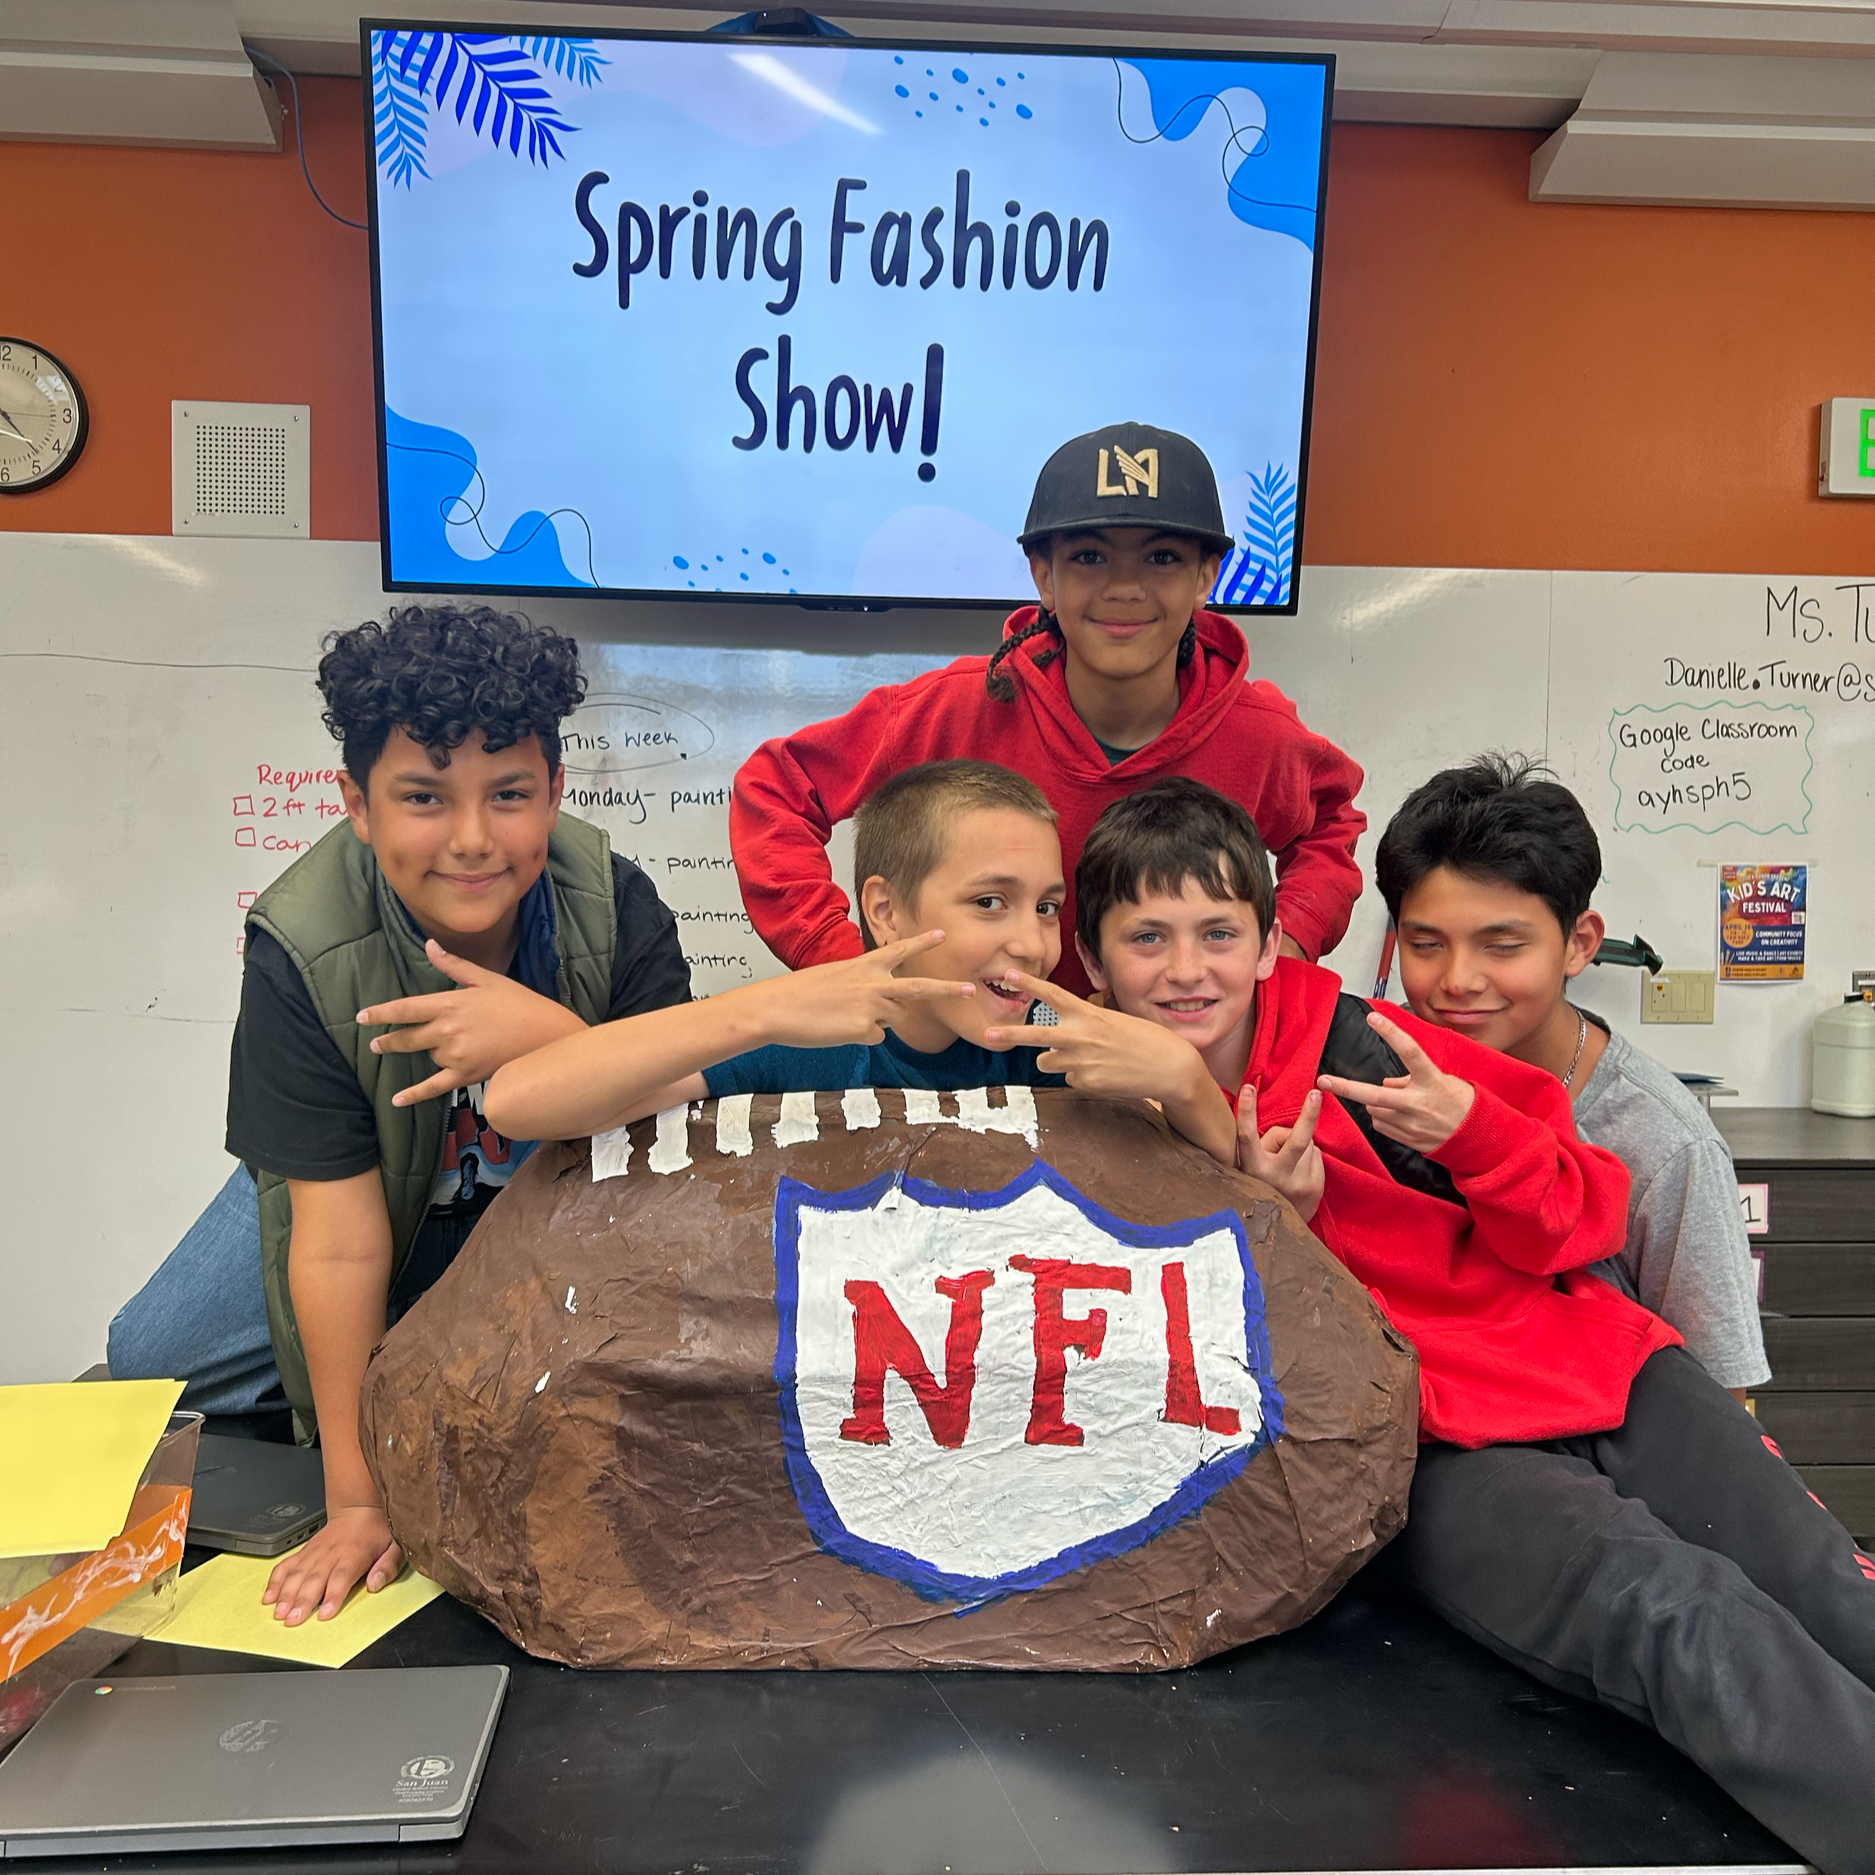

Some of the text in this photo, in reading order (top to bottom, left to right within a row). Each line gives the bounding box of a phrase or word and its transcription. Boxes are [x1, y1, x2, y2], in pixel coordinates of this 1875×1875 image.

[573, 169, 1110, 316] Spring Fashion
[32, 354, 38, 370] 1
[54, 376, 64, 393] 2
[62, 408, 72, 424] 3
[731, 334, 945, 483] Show!
[52, 439, 62, 454] 4
[0, 467, 10, 482] 6
[32, 460, 41, 476] 5
[561, 732, 611, 752] This
[1619, 718, 1798, 757] Google Classroom
[257, 763, 338, 793] Require
[1638, 771, 1752, 815] ayhsph5
[263, 797, 278, 817] 2
[283, 797, 305, 816] ft
[1727, 880, 1801, 904] KID'S ART
[1742, 901, 1787, 914] FESTIVAL
[1755, 930, 1785, 938] COMMUNITY
[1786, 930, 1803, 938] FOCUS
[1760, 938, 1798, 946] ON CREATIVITY
[685, 953, 753, 979] ainting
[839, 1253, 1242, 1449] NFL
[420, 1779, 448, 1787] Juan
